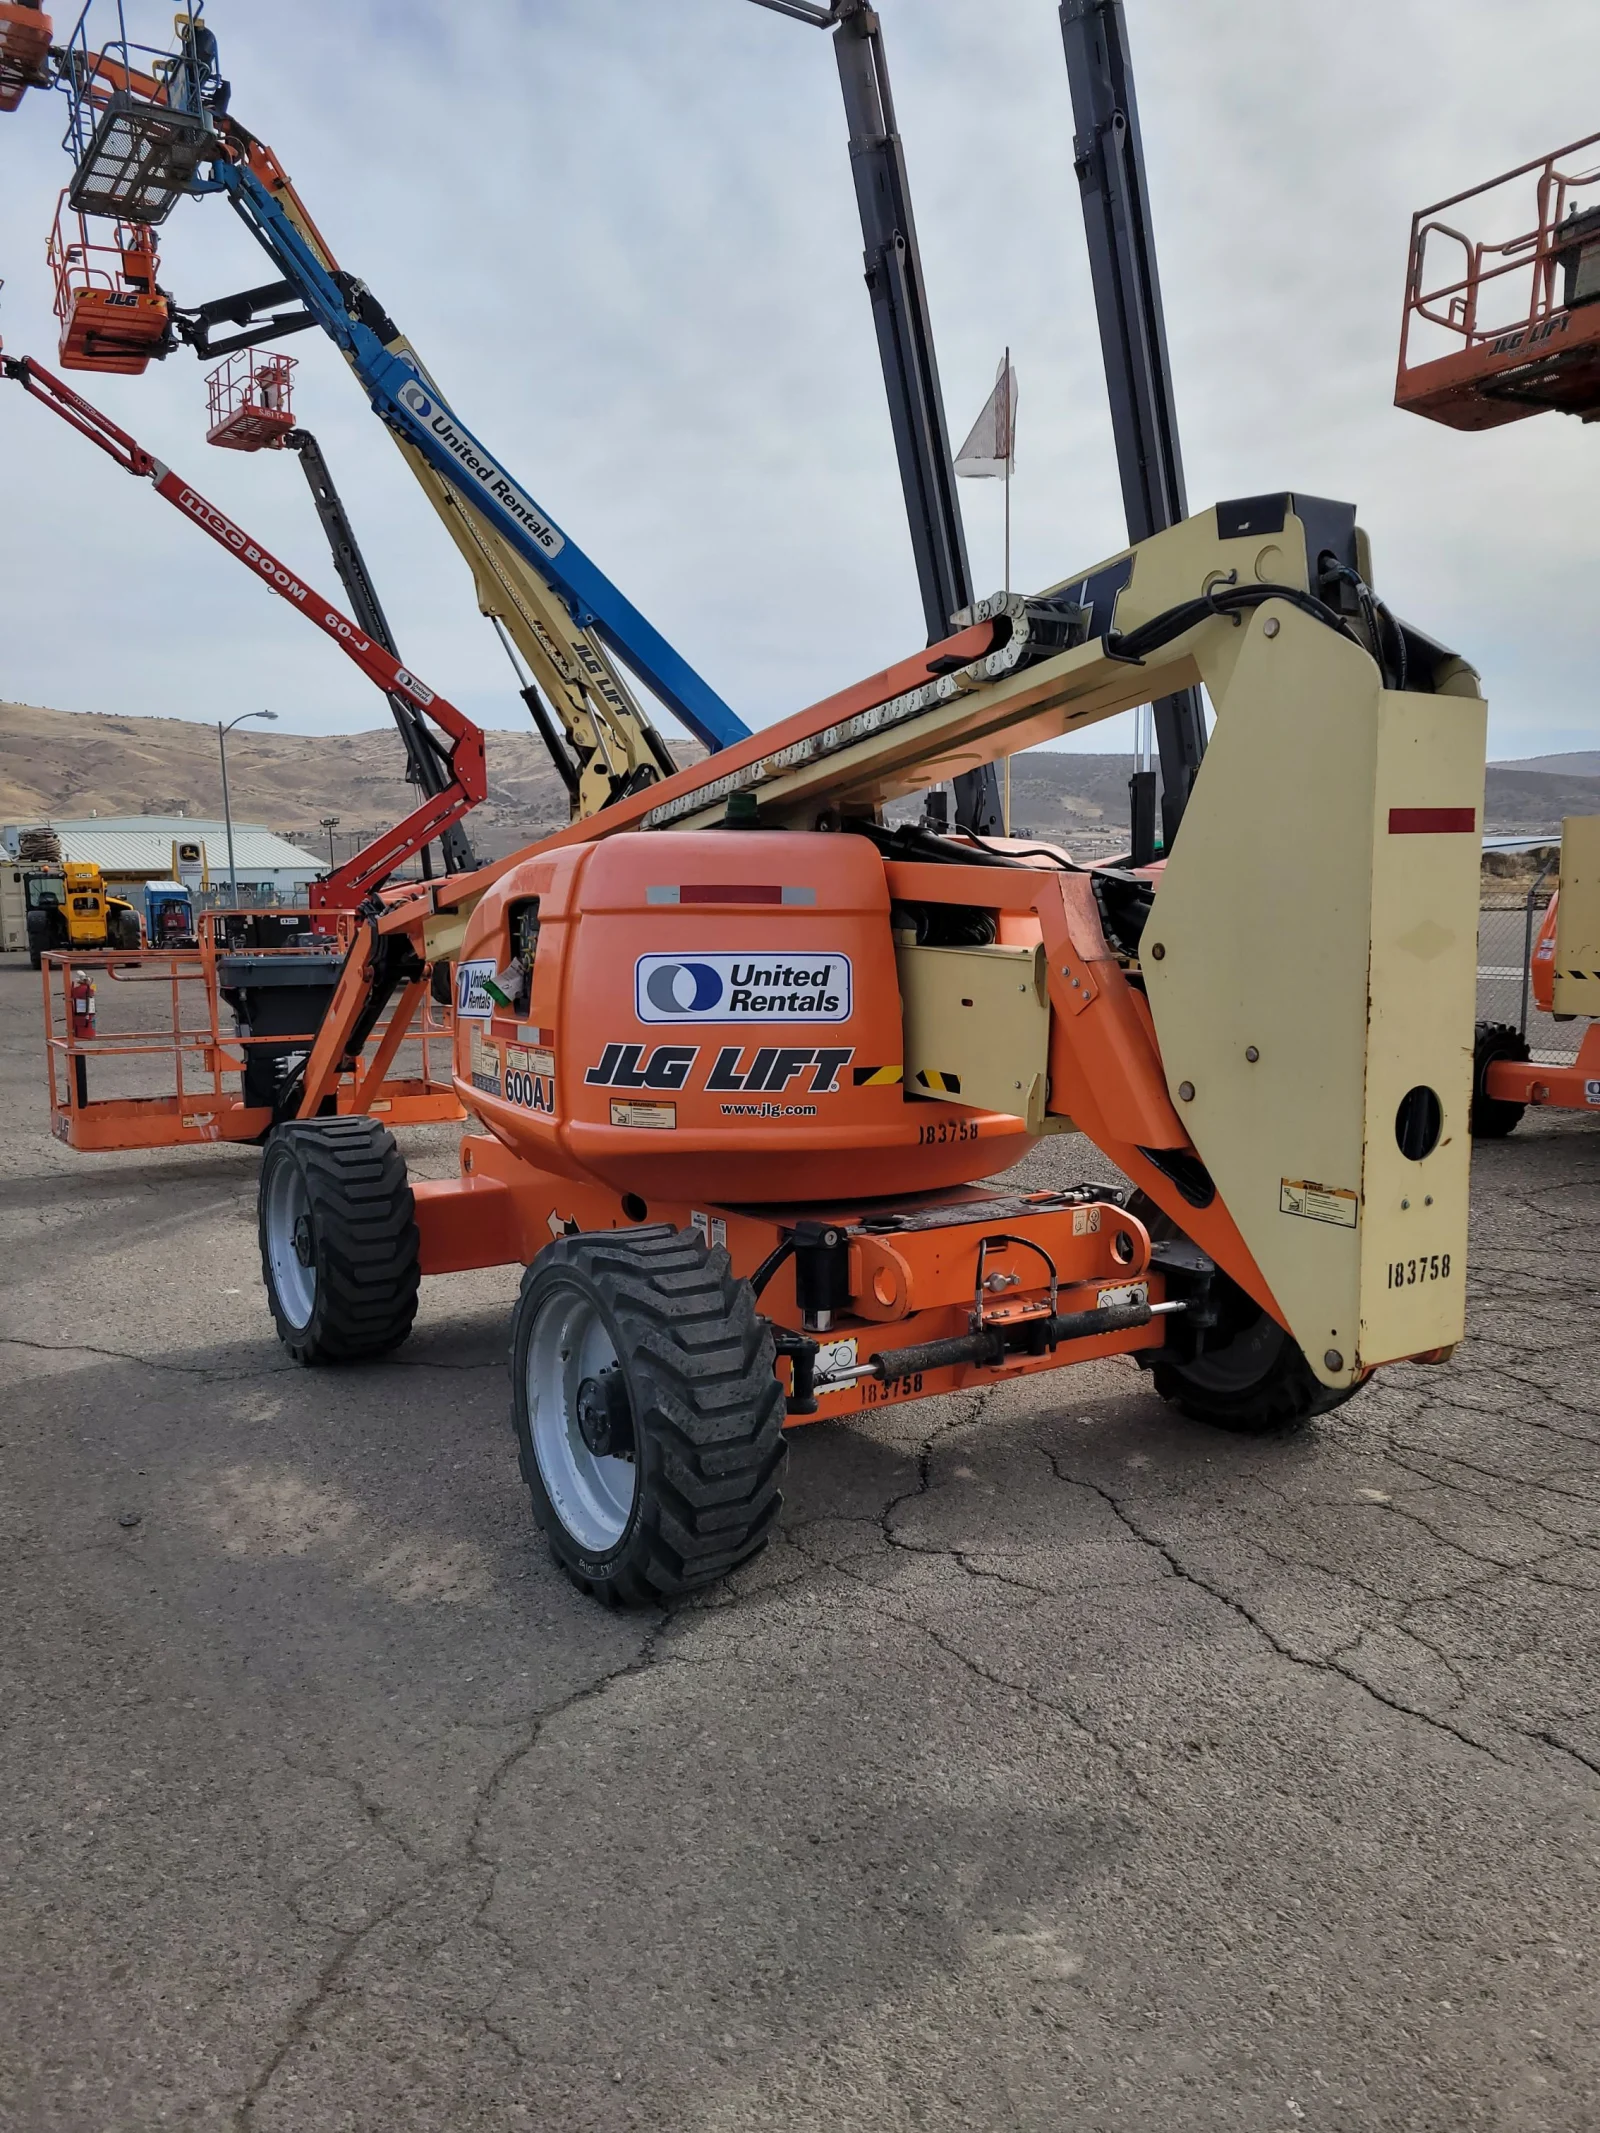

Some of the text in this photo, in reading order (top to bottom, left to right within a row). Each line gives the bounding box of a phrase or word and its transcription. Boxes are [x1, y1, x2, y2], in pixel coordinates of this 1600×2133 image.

[104, 292, 139, 308] JLG
[1487, 332, 1525, 358] JLG
[258, 409, 274, 417] SJ61
[431, 415, 495, 482] United
[490, 479, 554, 548] Rentals
[325, 613, 370, 652] 60-J
[412, 682, 431, 698] United
[571, 642, 631, 717] JLG LIFT
[410, 686, 429, 703] Rentals
[730, 964, 832, 987] United
[468, 991, 491, 1011] Rentals
[729, 989, 840, 1012] Rentals
[584, 1043, 701, 1091] JLG
[703, 1047, 855, 1093] LIFT
[505, 1068, 555, 1114] 600AJ
[720, 1103, 818, 1118] www.jlg.com
[919, 1119, 978, 1145] 183758
[1388, 1254, 1451, 1289] 183758
[861, 1374, 923, 1405] 183758
